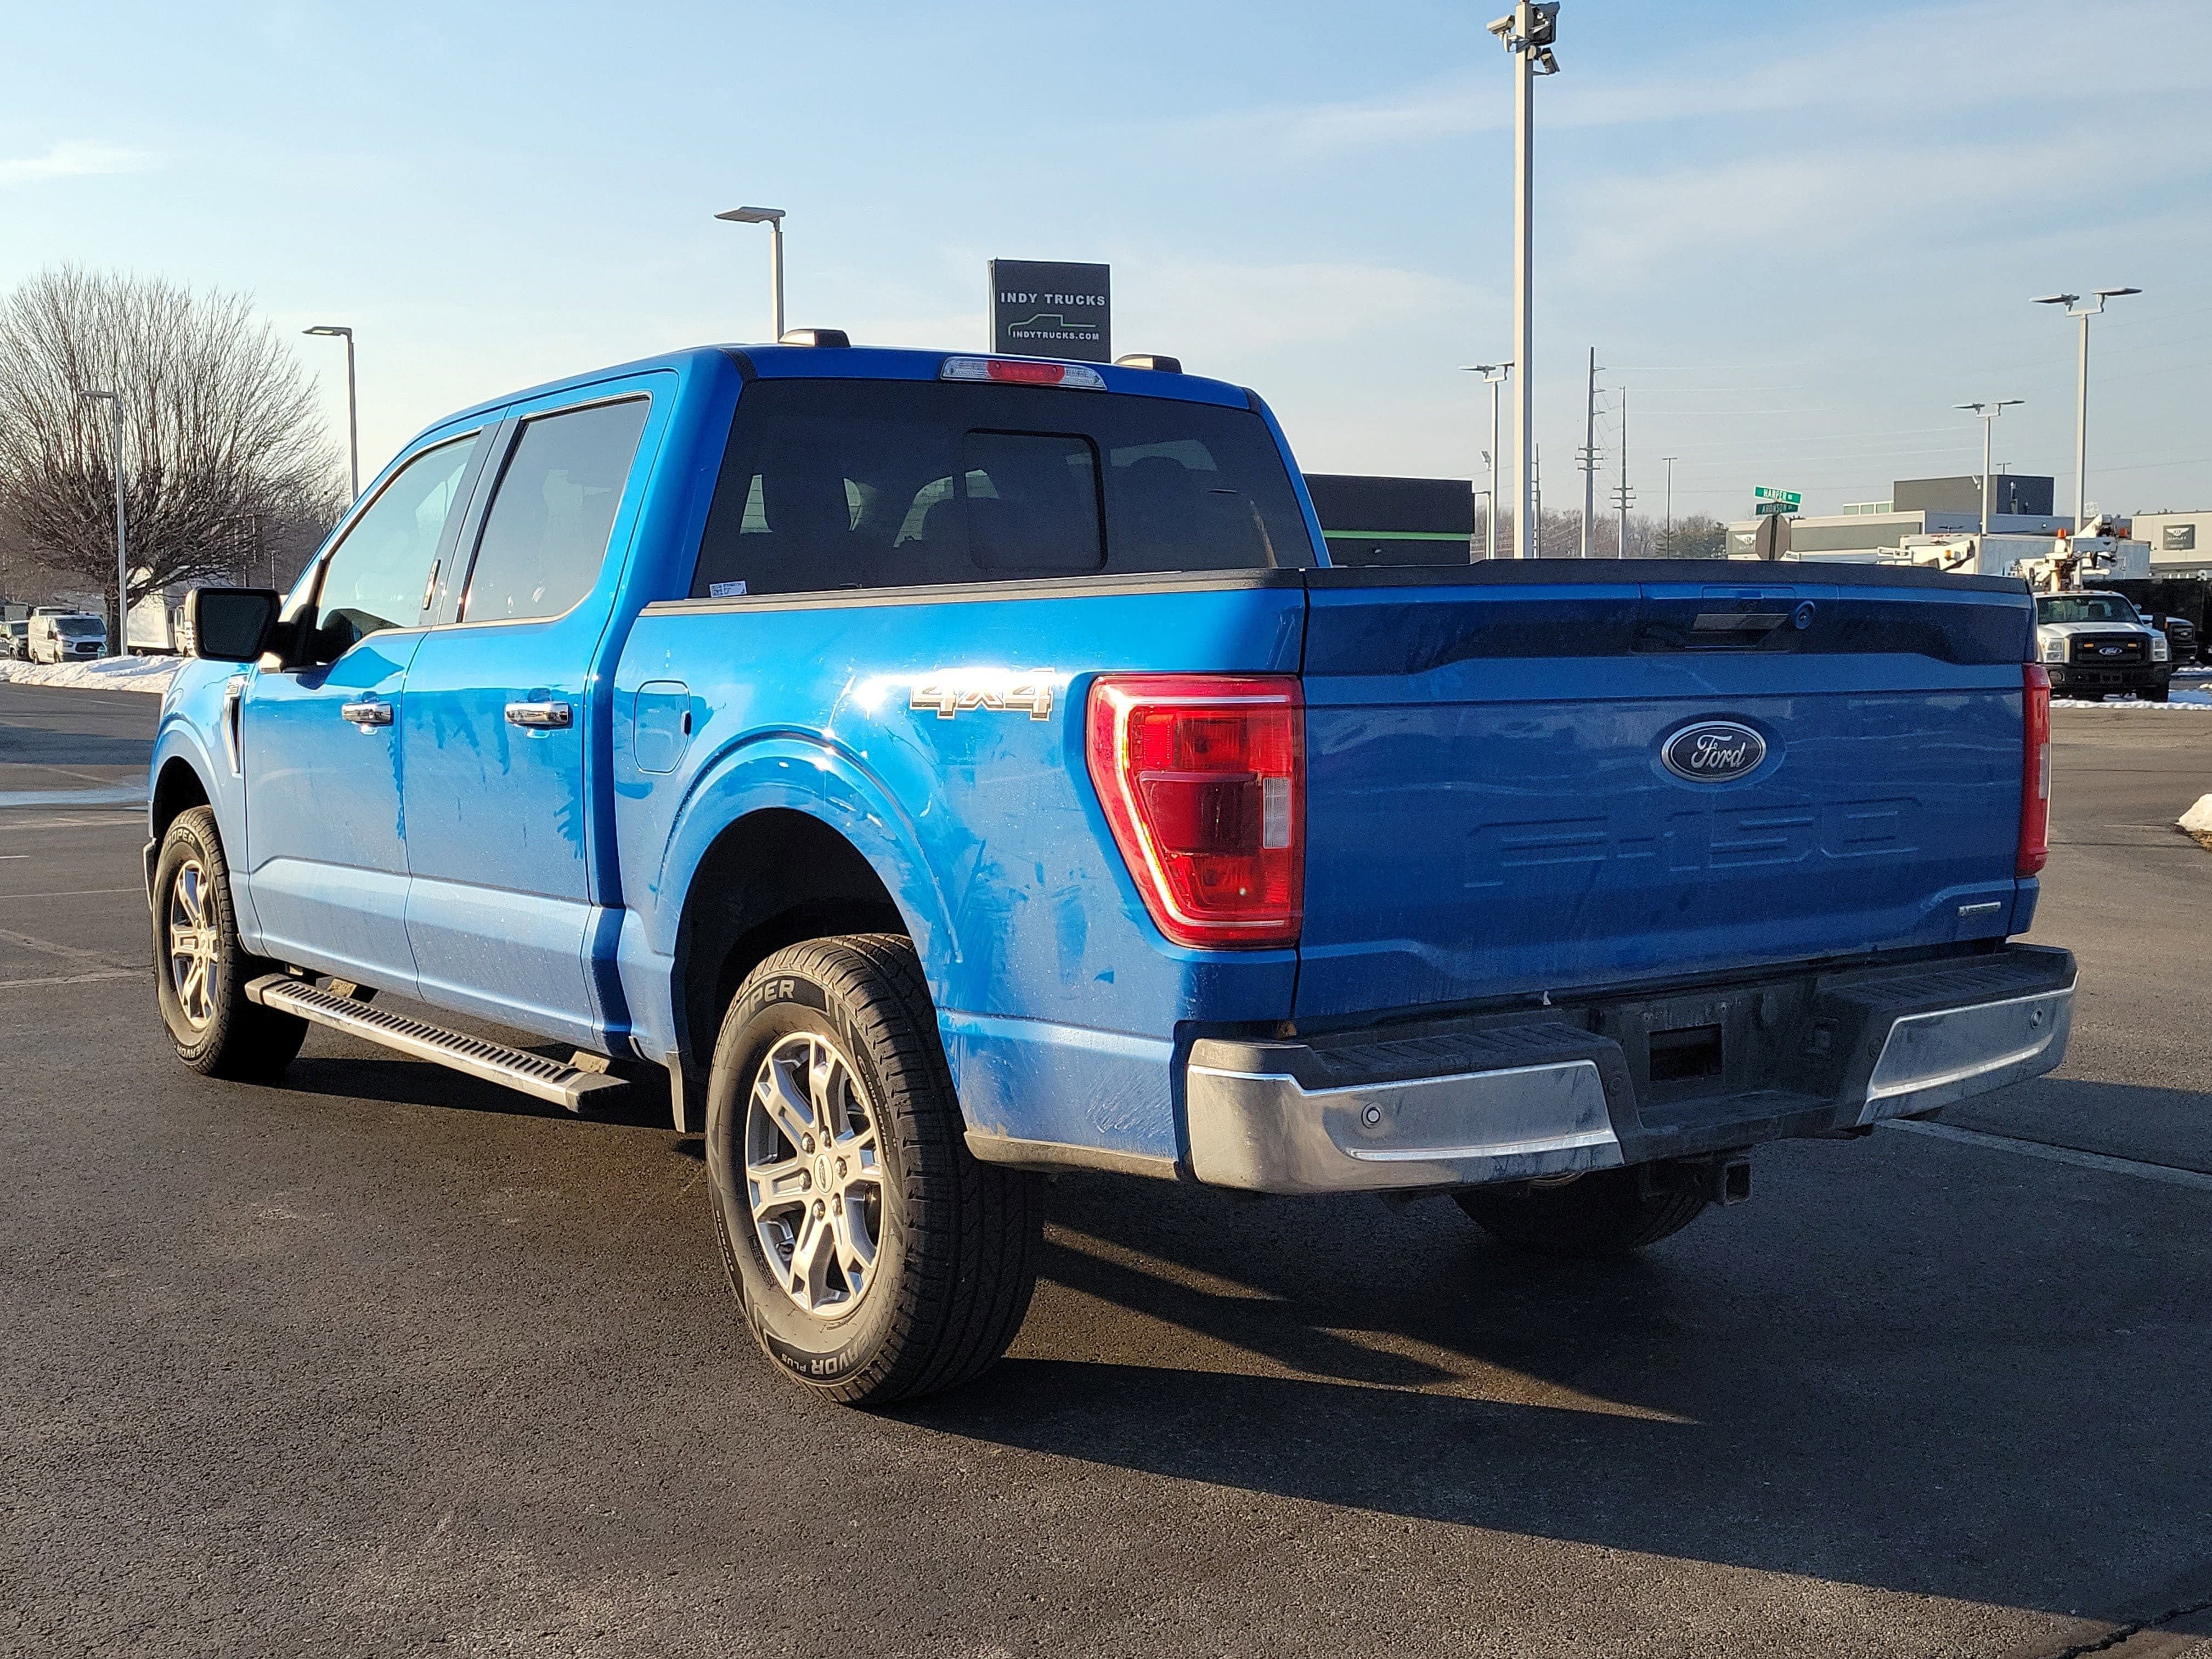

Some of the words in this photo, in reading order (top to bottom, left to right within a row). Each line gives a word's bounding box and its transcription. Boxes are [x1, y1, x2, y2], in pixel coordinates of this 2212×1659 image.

[1000, 292, 1038, 303] INDY
[1044, 294, 1106, 306] TRUCKS
[1012, 330, 1099, 340] INDYTRUCKS.COM
[1763, 488, 1787, 501] HARPER
[1691, 734, 1746, 768] Ford
[165, 828, 195, 850] OOPER
[781, 1352, 807, 1372] PLUS
